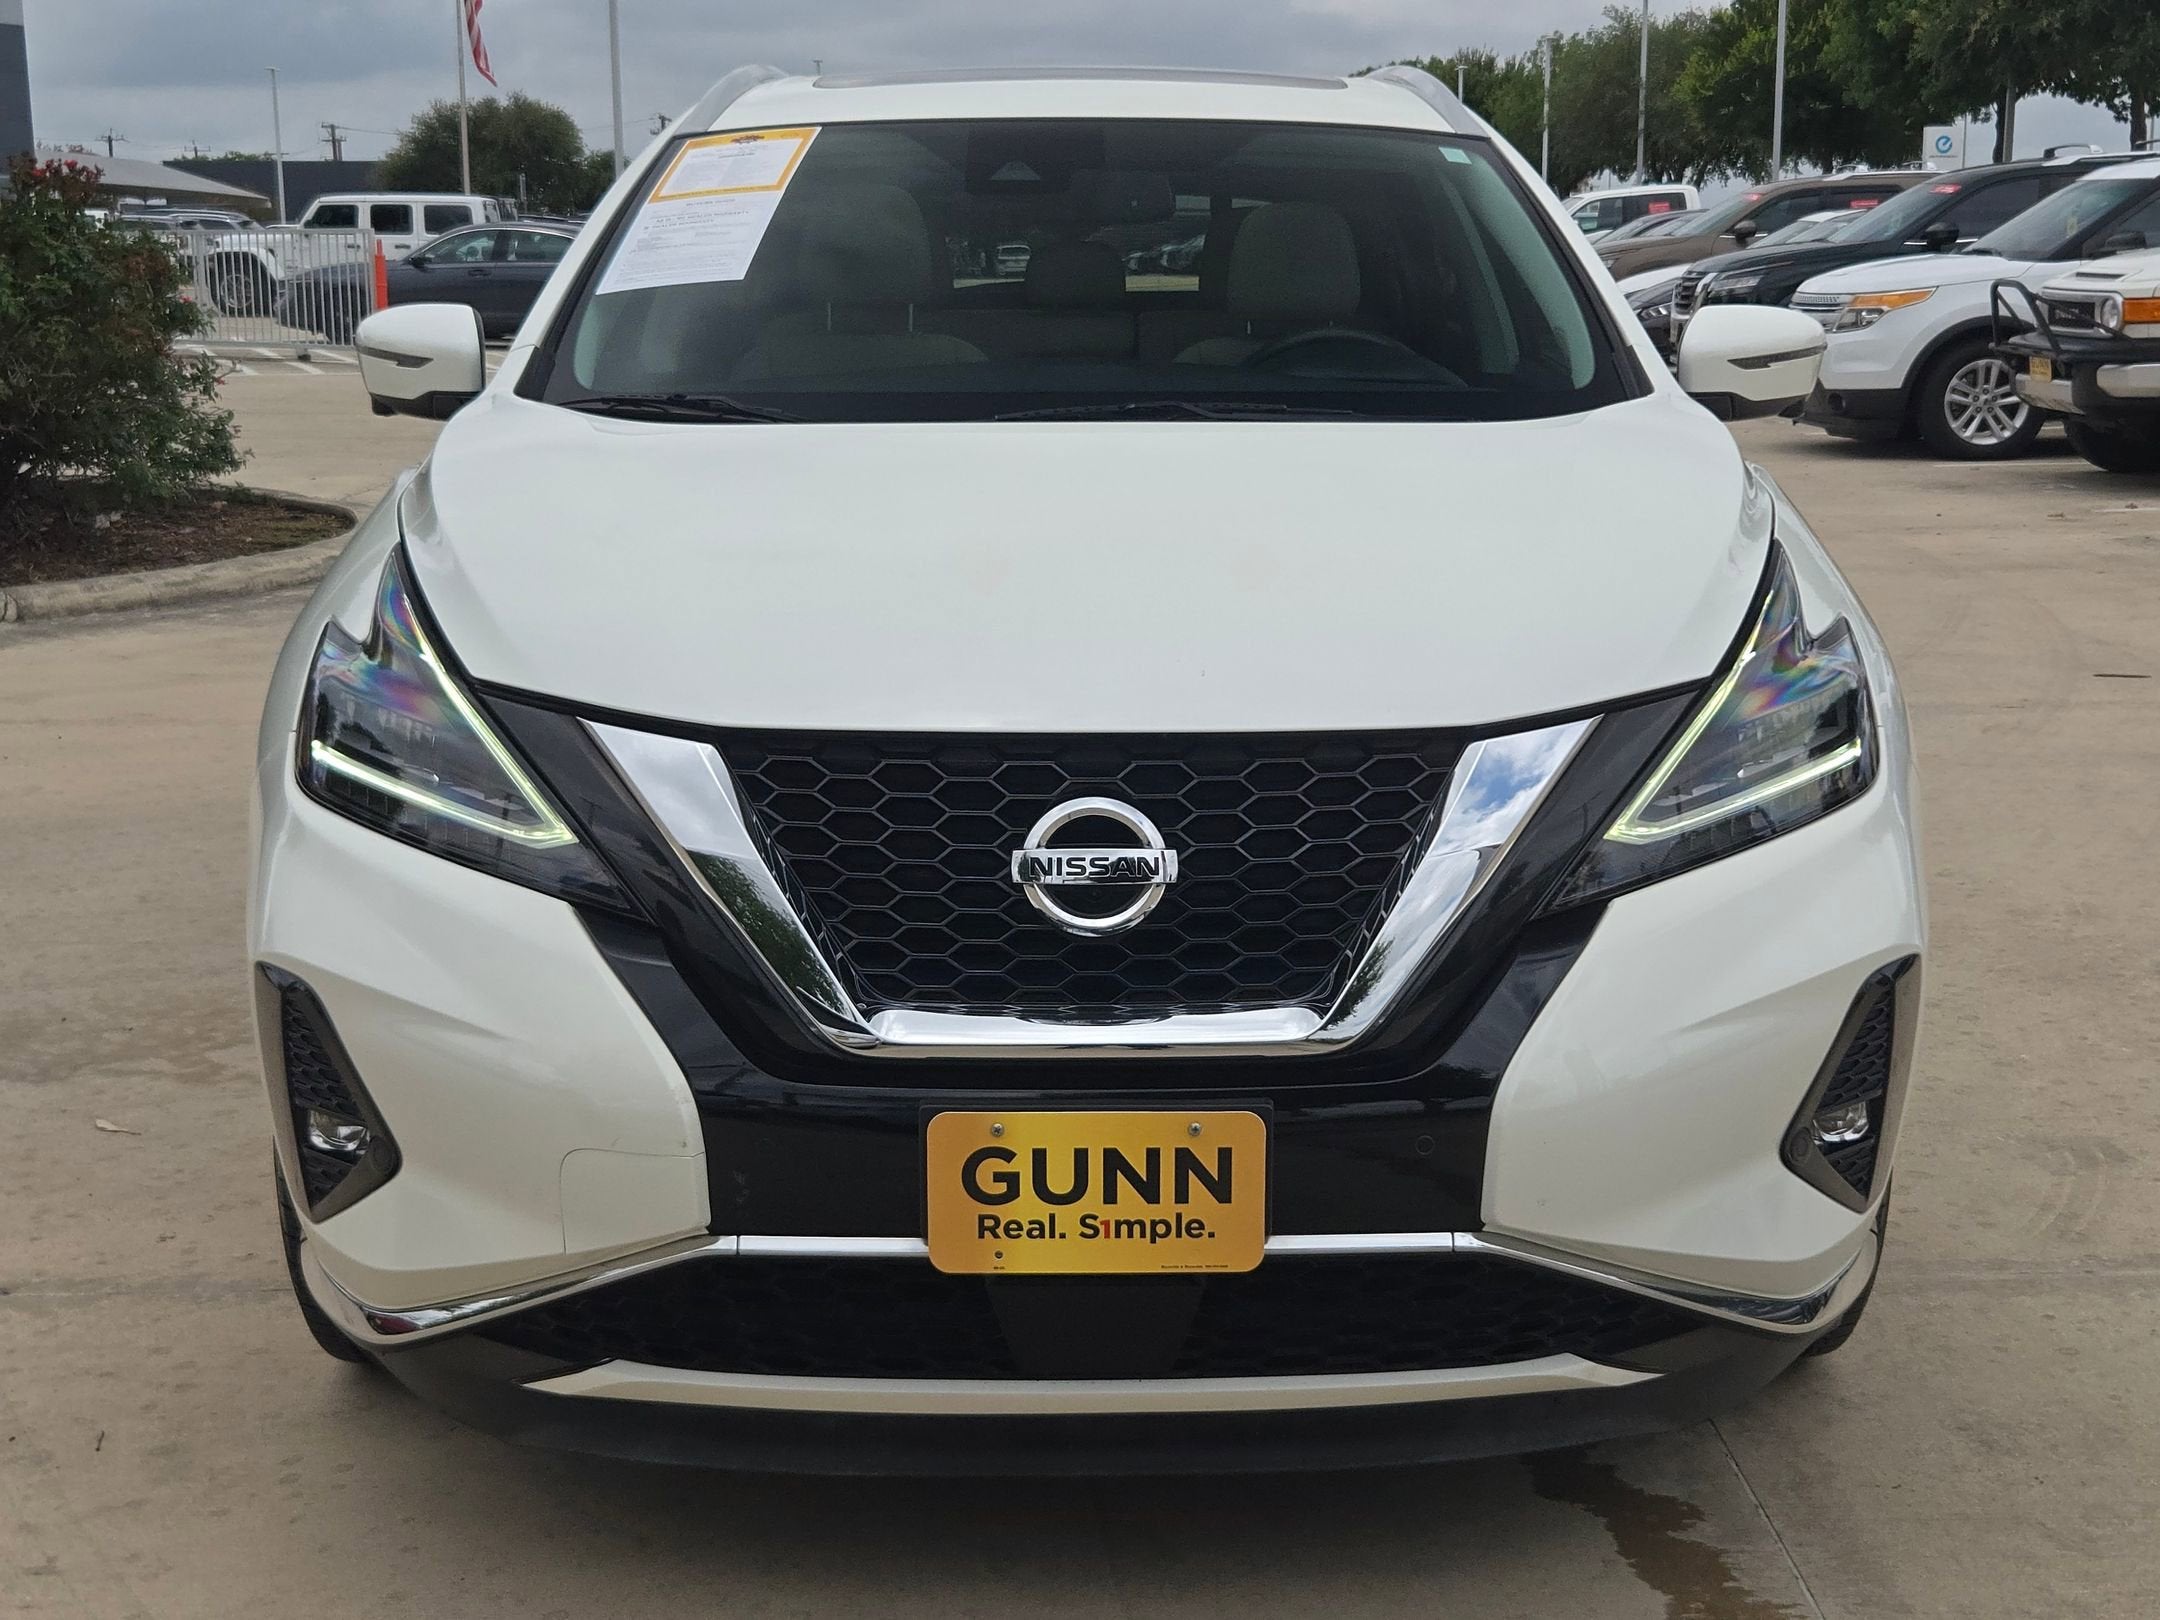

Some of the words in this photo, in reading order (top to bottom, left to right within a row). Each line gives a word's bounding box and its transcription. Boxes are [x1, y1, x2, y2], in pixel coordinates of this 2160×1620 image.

[1029, 856, 1160, 877] NISSAN
[961, 1146, 1232, 1206] GUNN
[977, 1213, 1067, 1240] Real.
